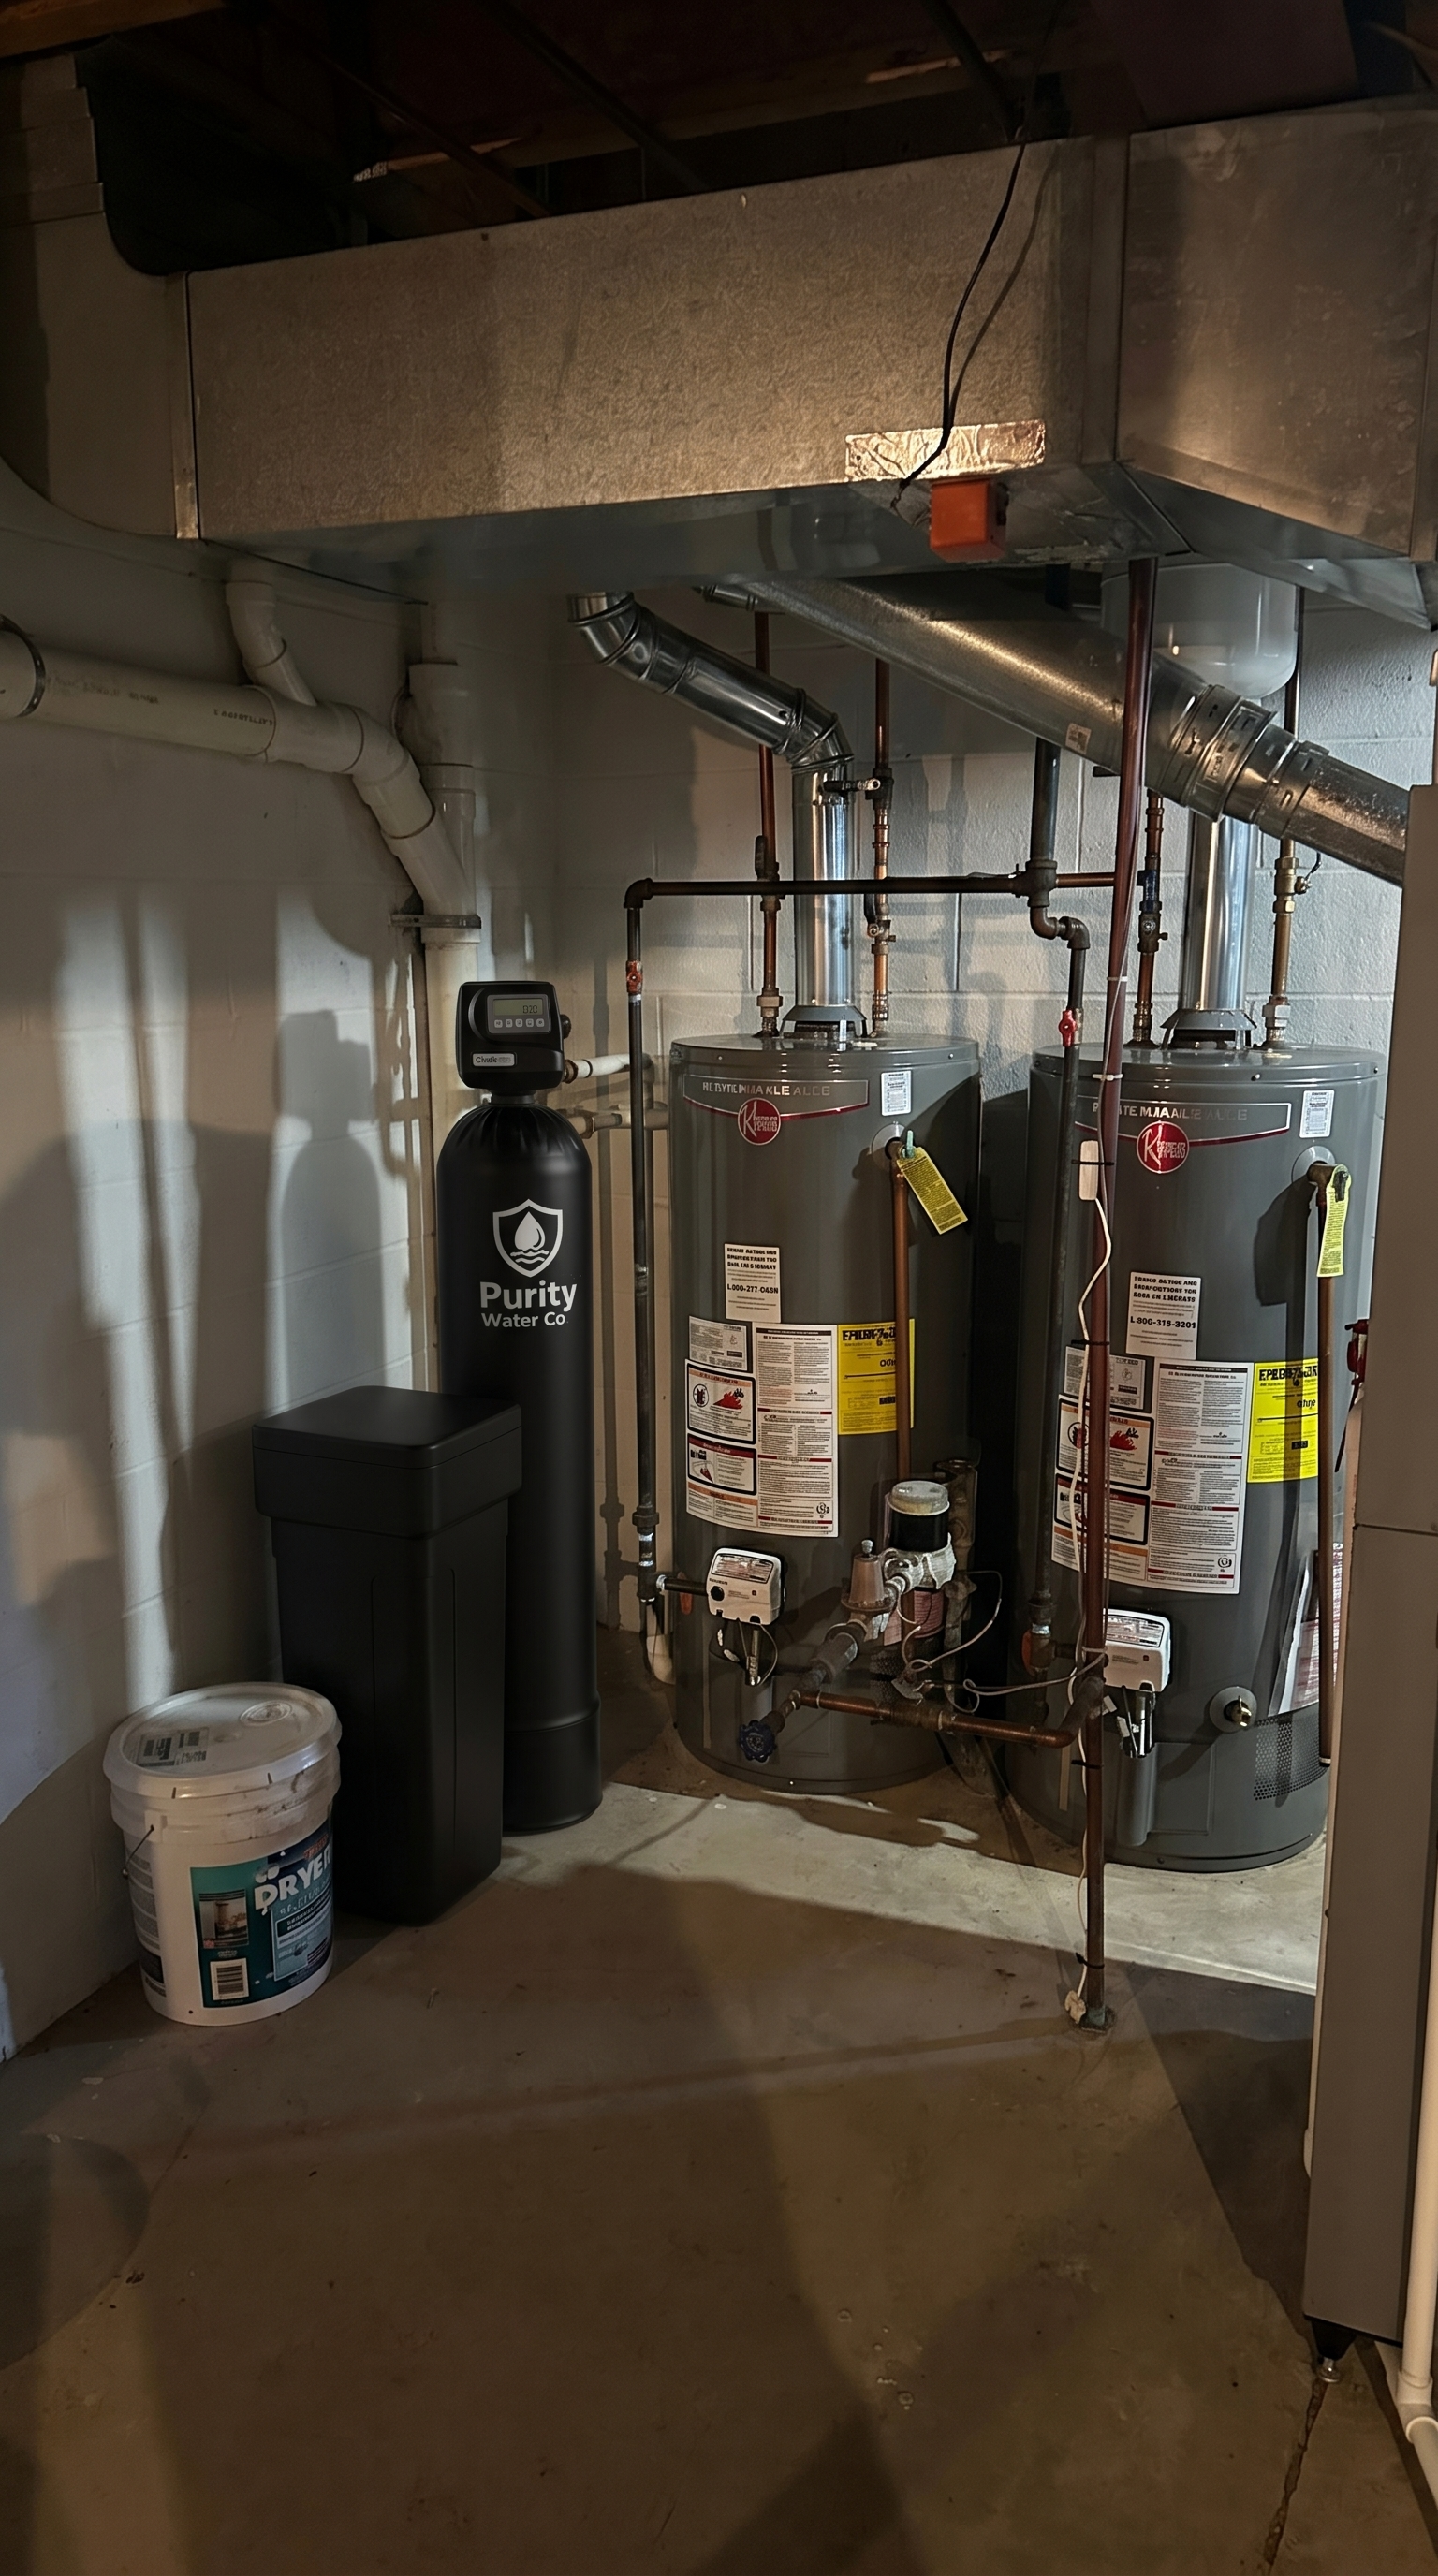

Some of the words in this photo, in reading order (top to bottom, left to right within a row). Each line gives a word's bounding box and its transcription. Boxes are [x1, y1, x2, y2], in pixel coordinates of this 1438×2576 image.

[479, 1279, 578, 1312] Purity
[480, 1312, 539, 1327] Water
[544, 1311, 565, 1326] Co
